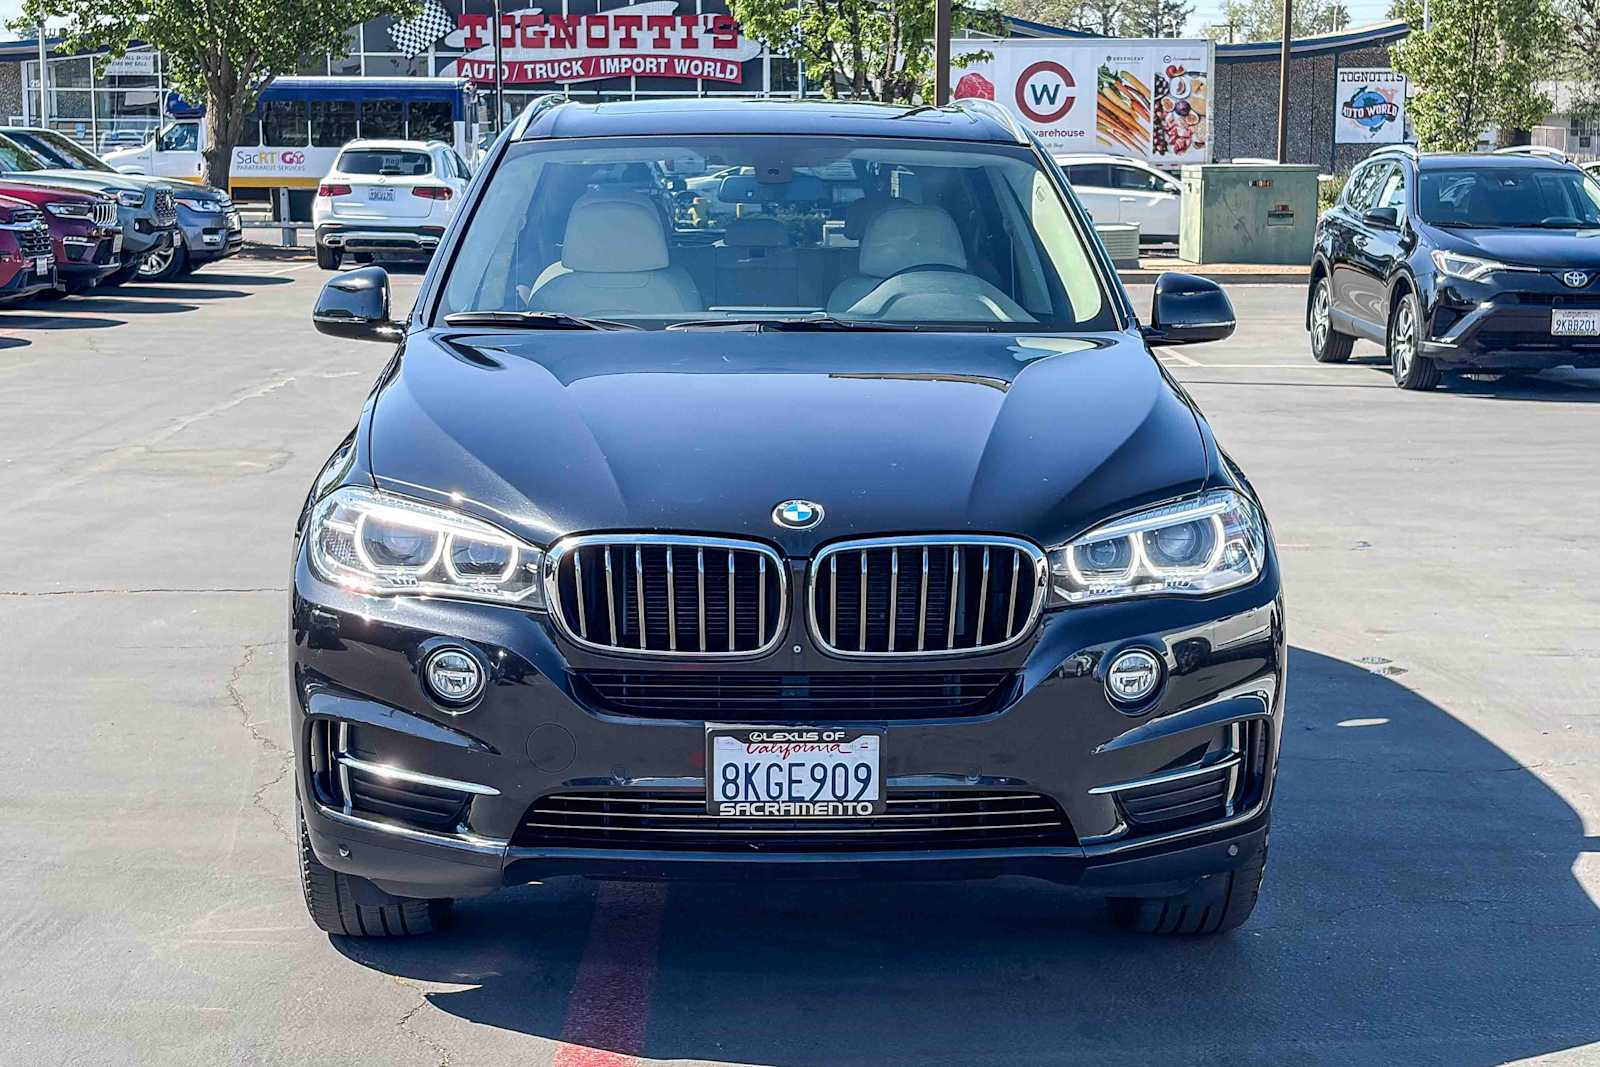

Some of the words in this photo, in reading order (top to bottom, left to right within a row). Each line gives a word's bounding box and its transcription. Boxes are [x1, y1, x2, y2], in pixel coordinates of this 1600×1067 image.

[457, 14, 737, 49] TOGNOTTI'S
[460, 62, 509, 80] AUTO
[524, 60, 584, 79] TRUCK
[600, 56, 667, 75] IMPORT
[673, 59, 738, 80] WORLD
[1343, 106, 1365, 118] AUTO
[1366, 103, 1398, 117] WORLD
[236, 151, 277, 165] SacRT
[1556, 319, 1595, 331] 9KBB201
[762, 732, 819, 742] LEXUS
[822, 731, 846, 742] OF
[746, 742, 853, 760] California
[721, 762, 873, 801] 8KGE909
[719, 801, 874, 816] SACRAMENTO
